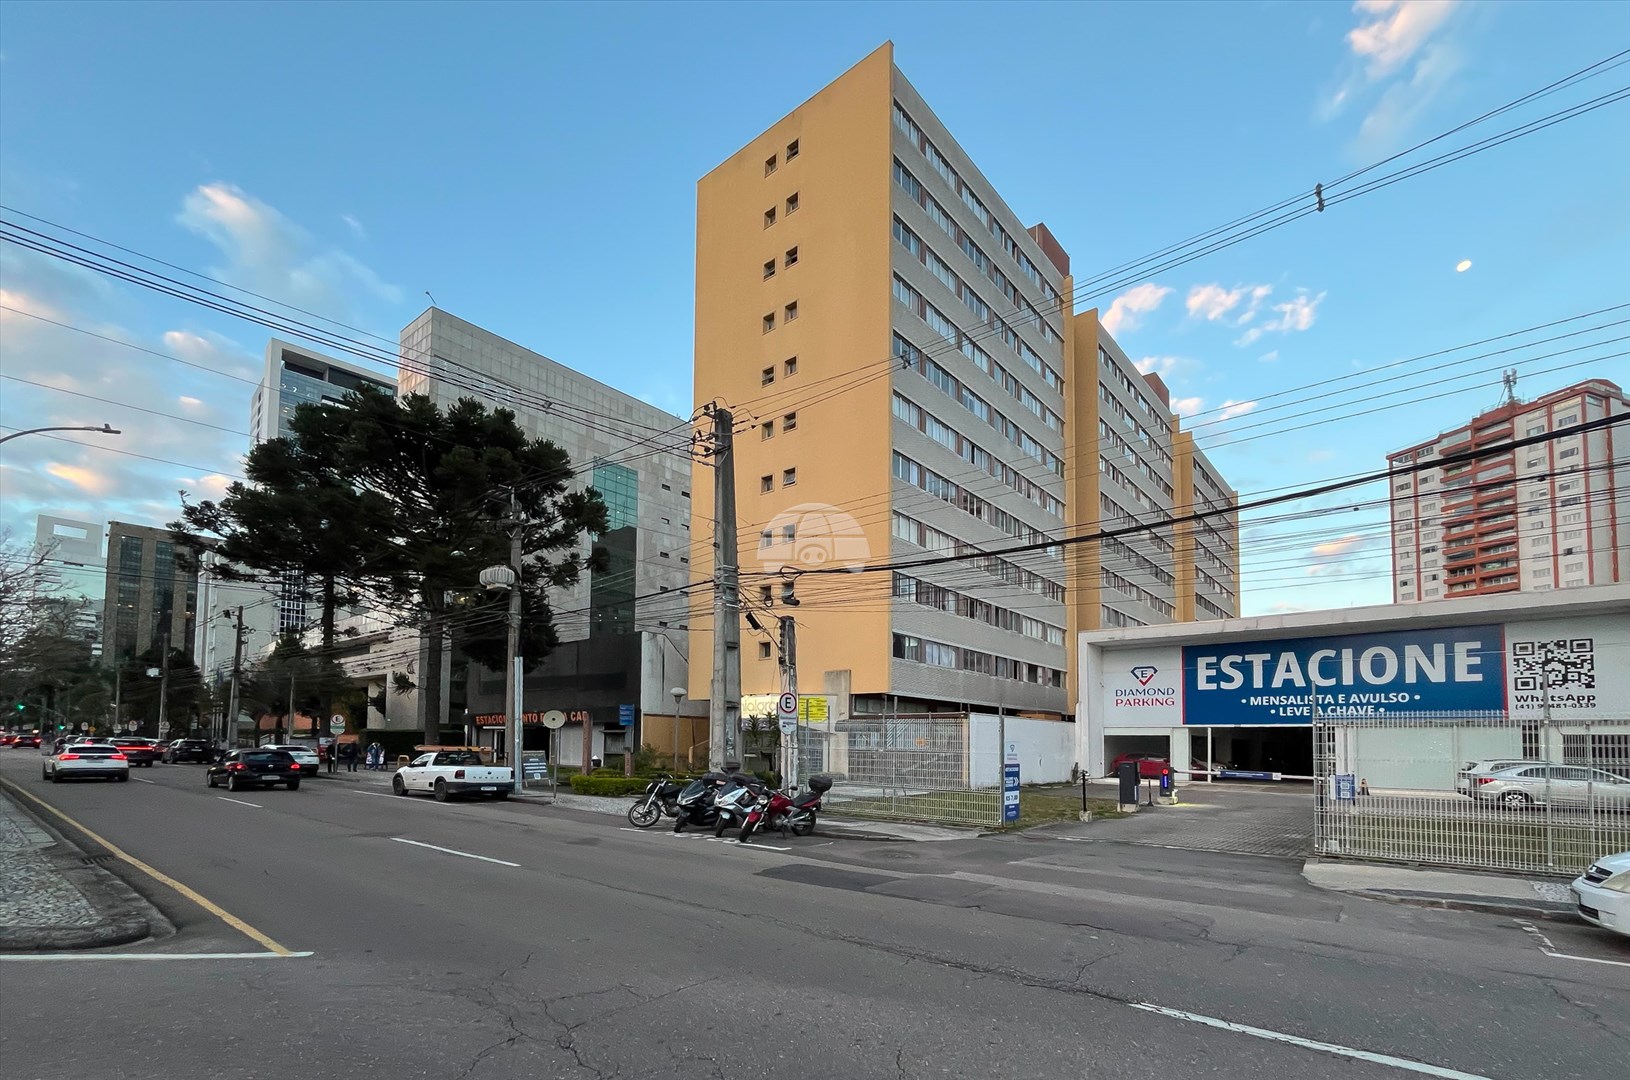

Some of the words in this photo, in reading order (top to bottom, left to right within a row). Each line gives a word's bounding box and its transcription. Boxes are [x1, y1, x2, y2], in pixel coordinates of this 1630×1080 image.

[1197, 641, 1483, 691] ESTACIONE
[1140, 669, 1148, 678] E
[1115, 687, 1175, 697] DIAMOND
[785, 697, 791, 708] E
[1115, 697, 1175, 707] PARKING
[1338, 694, 1346, 704] E
[1349, 692, 1410, 703] AVULSO
[1279, 706, 1310, 717] LEVE
[1327, 705, 1375, 716] CHAVE
